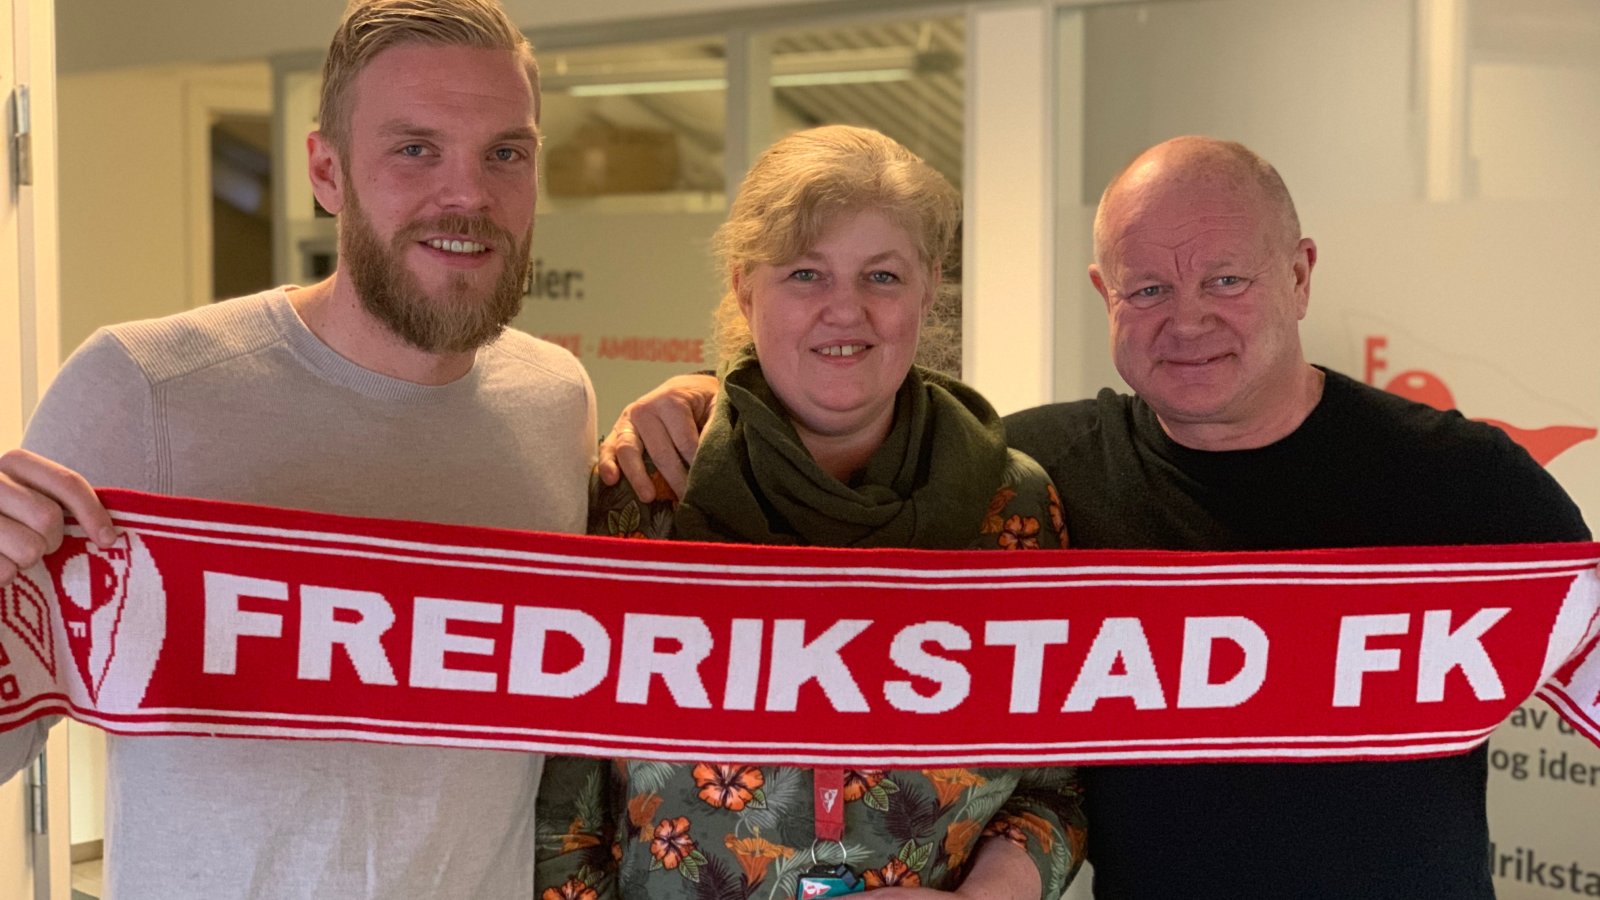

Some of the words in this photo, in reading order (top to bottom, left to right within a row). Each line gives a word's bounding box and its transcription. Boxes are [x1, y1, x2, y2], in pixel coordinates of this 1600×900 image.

[528, 257, 584, 299] ier:
[203, 571, 1269, 713] FREDRIKSTAD
[1332, 607, 1512, 706] FK
[1491, 750, 1529, 780] og
